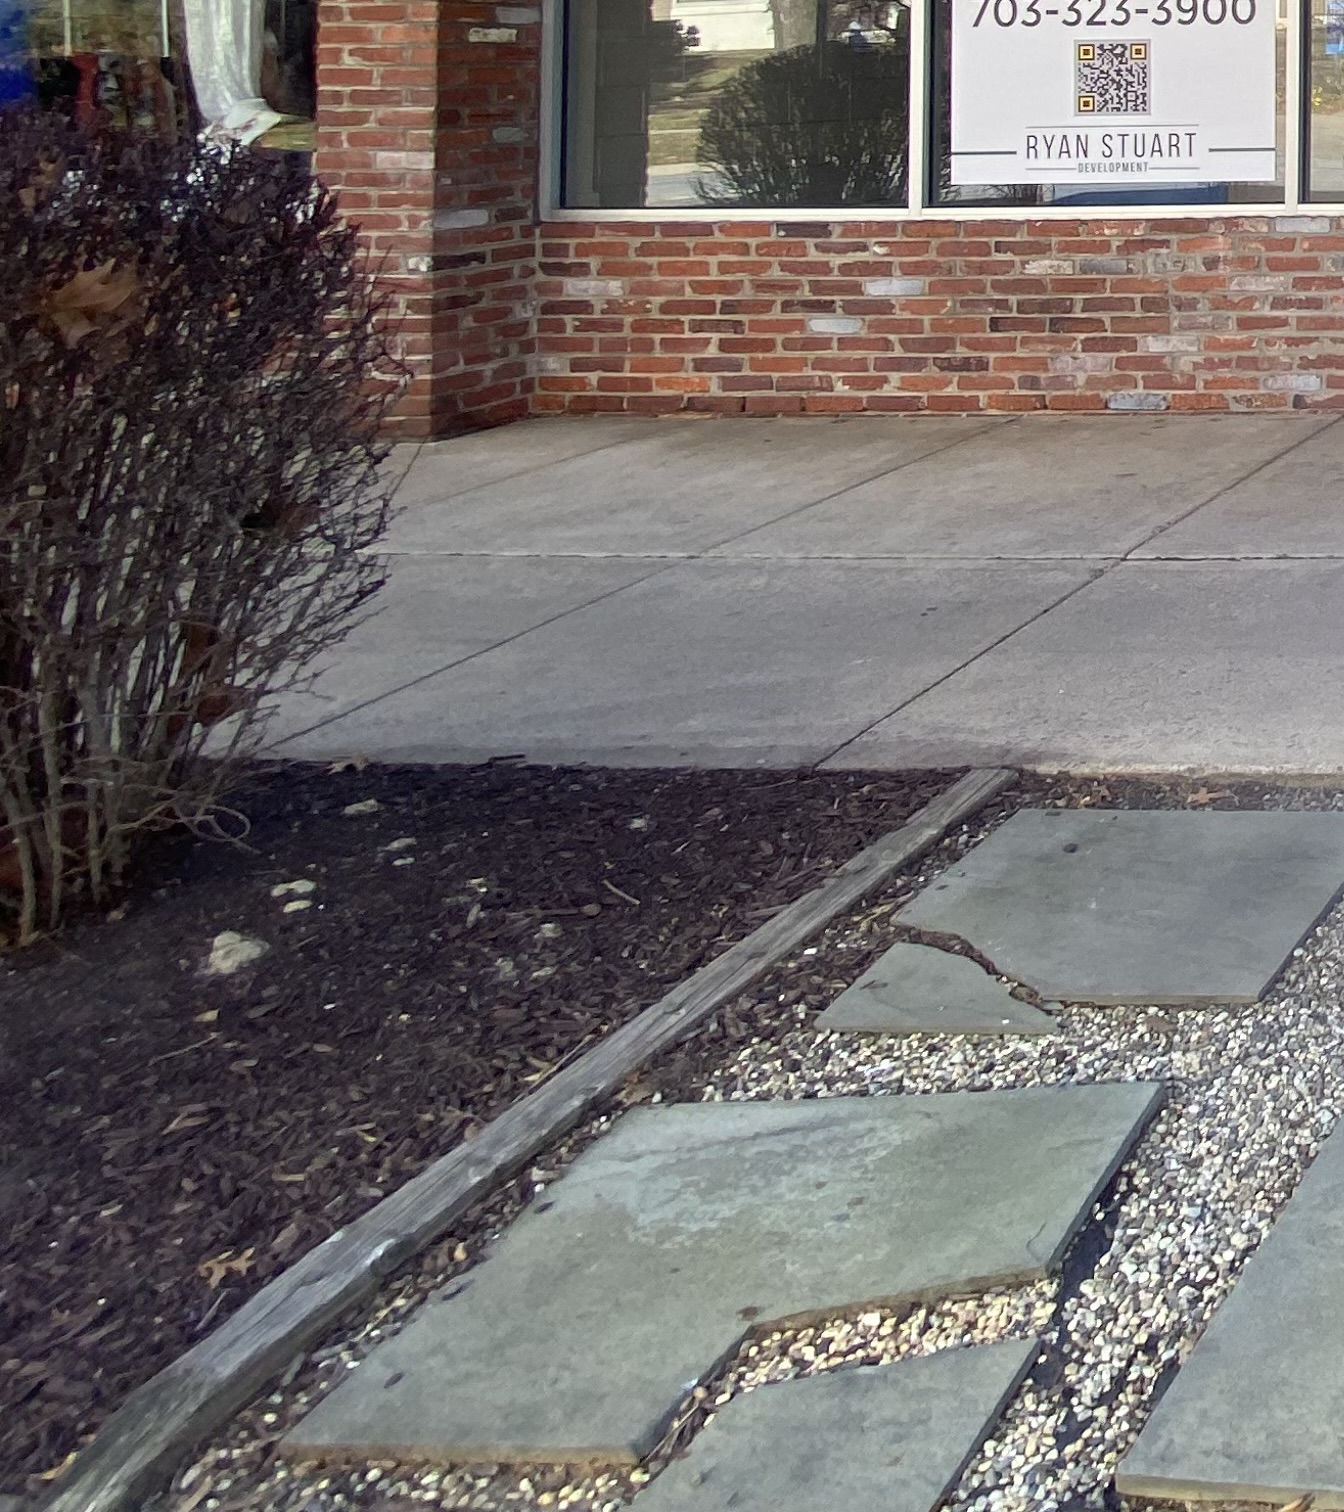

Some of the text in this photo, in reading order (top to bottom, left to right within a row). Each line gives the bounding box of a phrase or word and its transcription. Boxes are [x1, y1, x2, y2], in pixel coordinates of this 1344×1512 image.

[1025, 132, 1198, 160] RYAN STUART
[1076, 161, 1149, 174] DEVELOPMENT
